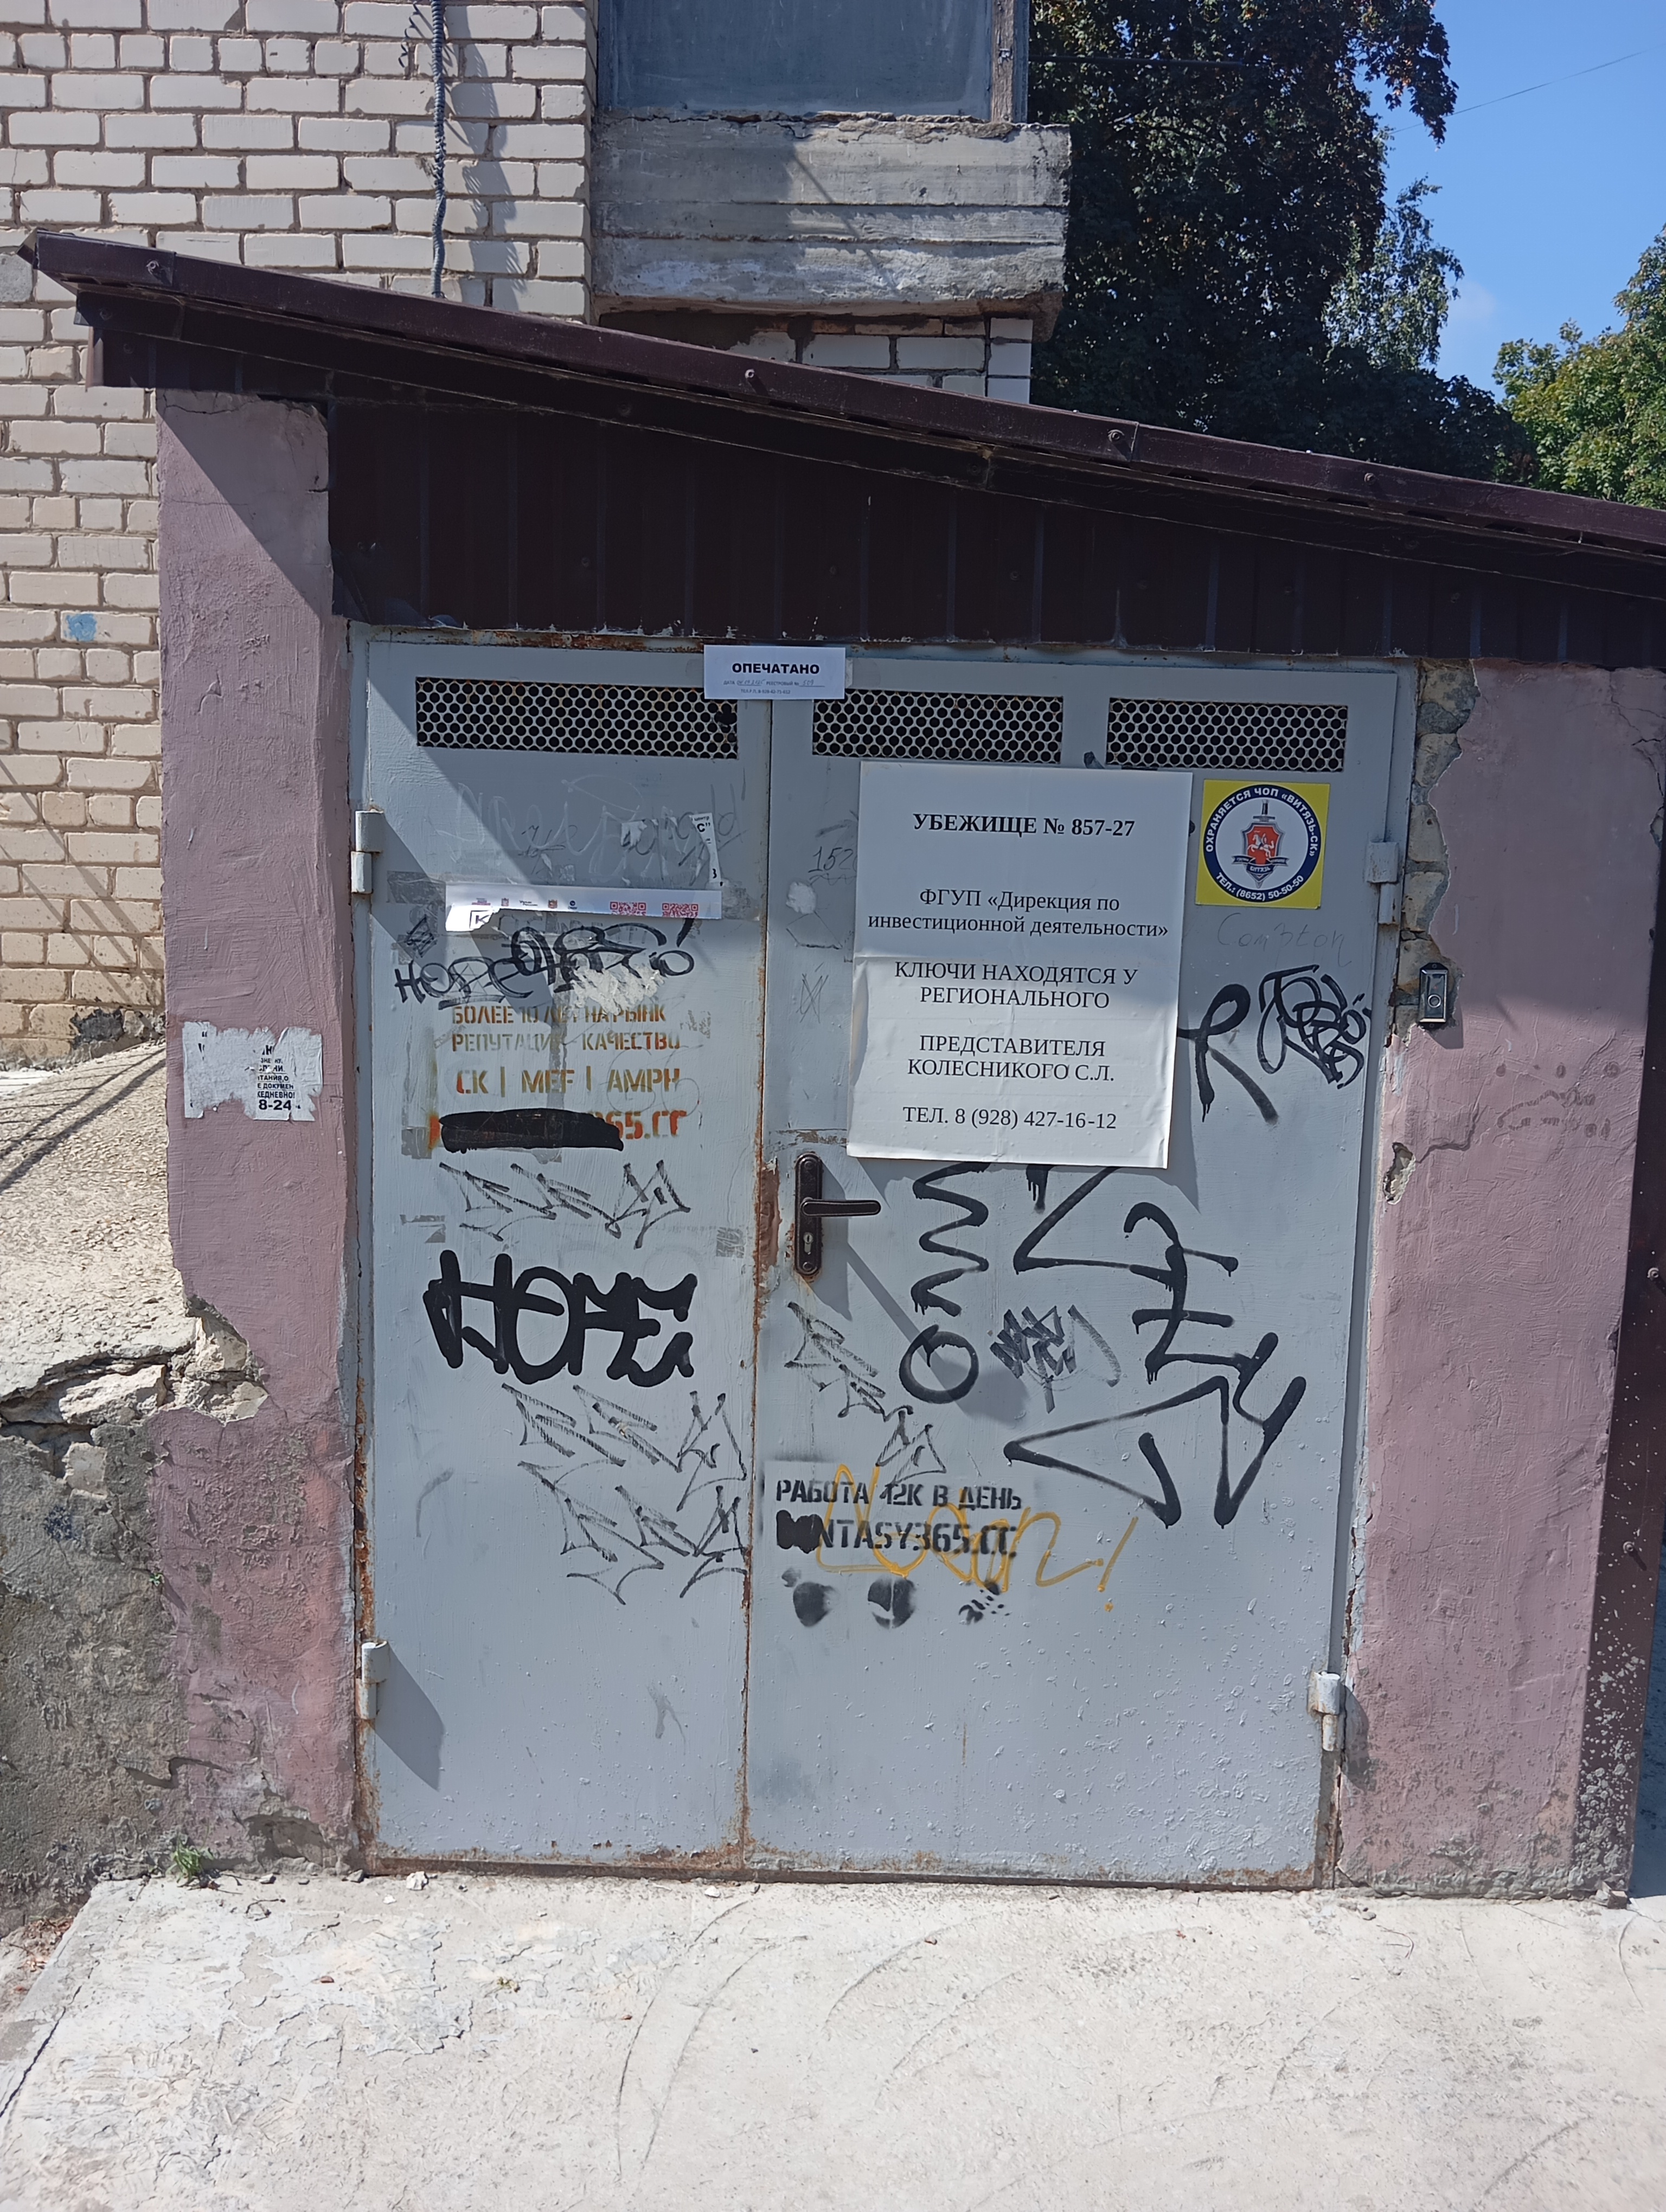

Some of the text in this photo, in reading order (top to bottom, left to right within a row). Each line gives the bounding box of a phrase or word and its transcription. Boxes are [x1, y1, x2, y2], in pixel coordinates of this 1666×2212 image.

[732, 663, 819, 674] ОПЕЧАТАНО
[913, 813, 1135, 838] УБЕЖИЩЕ № 857-27
[1206, 787, 1318, 857] ОХРАНЯЕТСЯ ЧОП «ВИТЯЗЬ-СК»
[1216, 872, 1304, 902] ТЕЛ.: (8652) 50-50-50
[920, 888, 1120, 914] ФГУП «Дирекция по
[868, 915, 1168, 937] инвестиционной деятельности»
[894, 961, 1138, 987] КЛЮЧИ НАХОДЯТСЯ У
[920, 986, 1110, 1008] РЕГИОНАЛЬНОГО
[453, 1005, 514, 1024] БОЛЕЕ
[452, 1032, 681, 1052] РЕПУТАЦИ КАЧЕСТВО
[919, 1035, 1106, 1057] ПРЕДСТАВИТЕЛЯ
[907, 1058, 1114, 1082] КОЛЕСНИКОГО С.Л.
[259, 1099, 292, 1110] 8-24
[902, 1107, 1117, 1130] ТЕЛ. 8 (928) 427-16-12
[776, 1480, 869, 1504] РАБОТА
[933, 1485, 948, 1507] В
[959, 1486, 1022, 1510] ДЕНЬ
